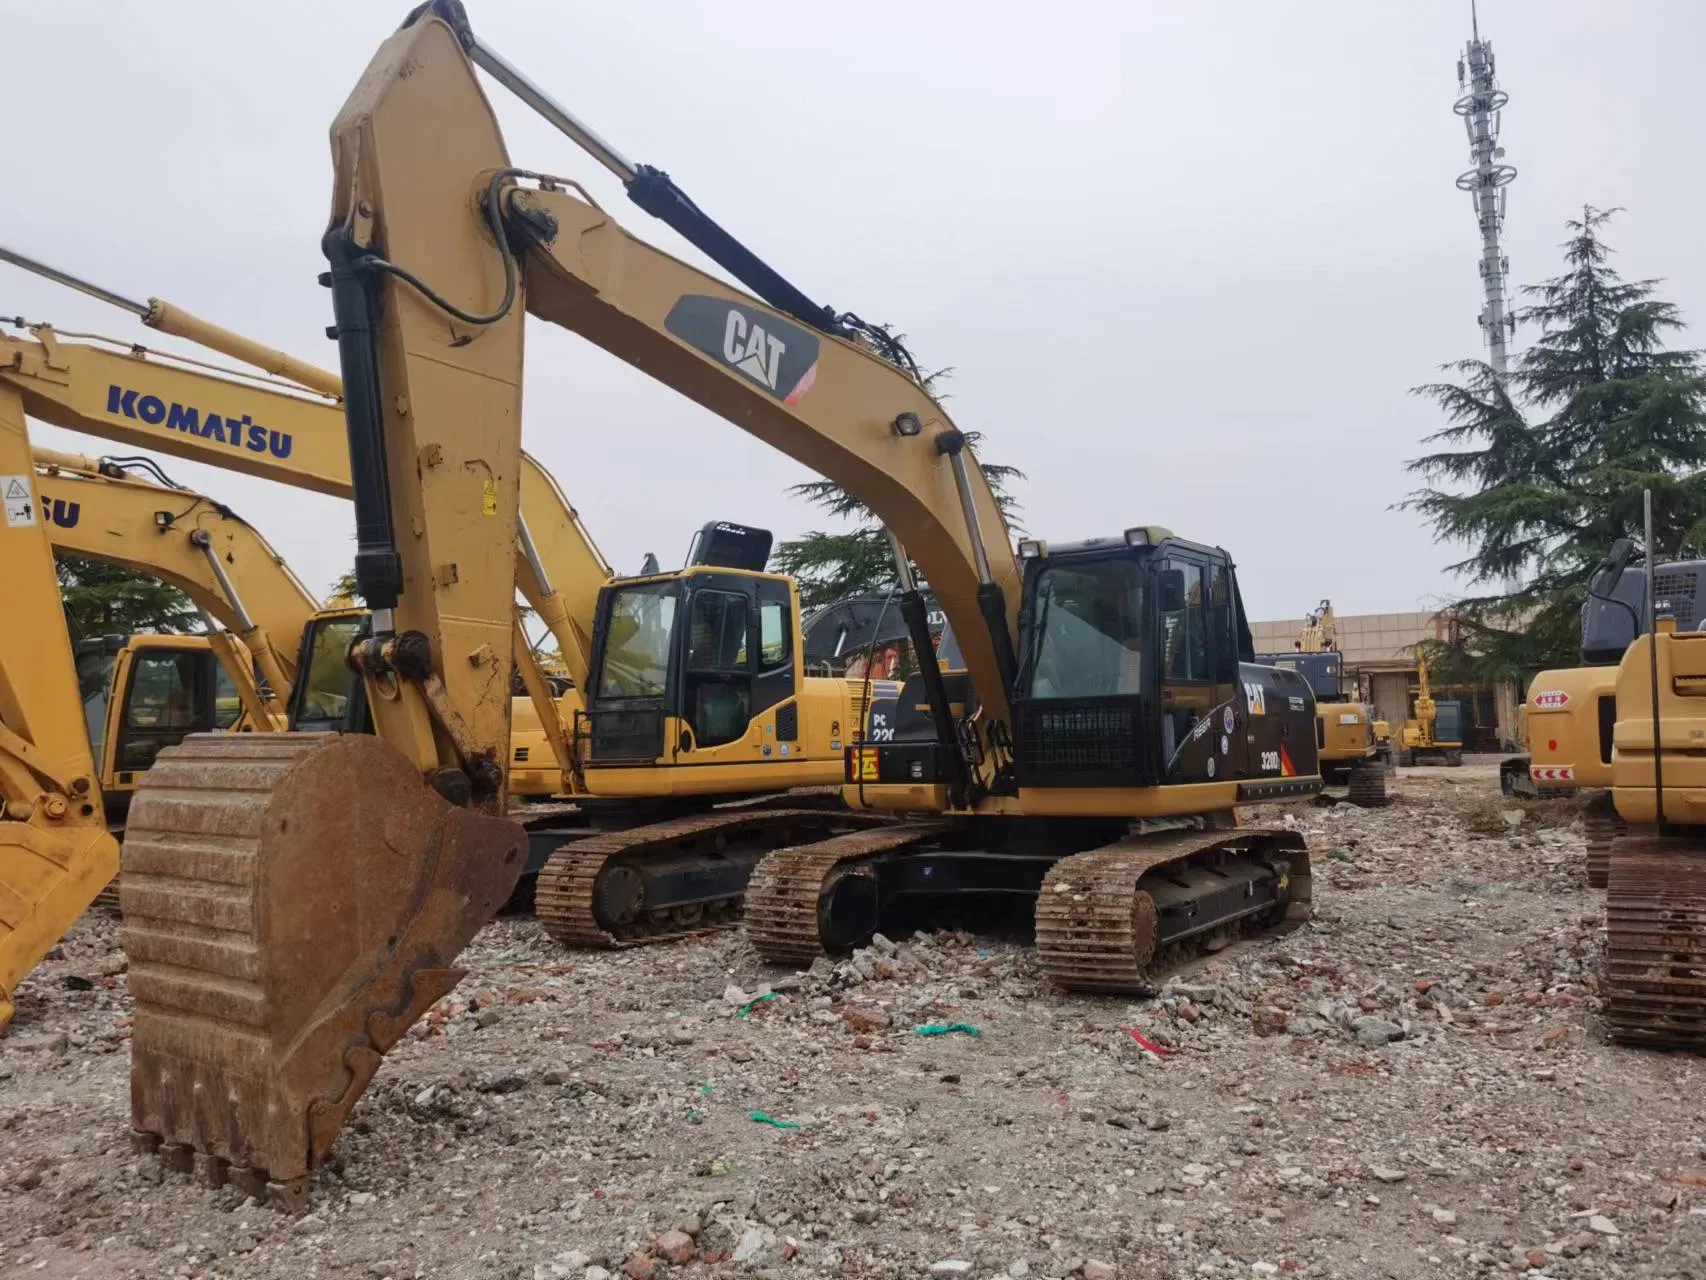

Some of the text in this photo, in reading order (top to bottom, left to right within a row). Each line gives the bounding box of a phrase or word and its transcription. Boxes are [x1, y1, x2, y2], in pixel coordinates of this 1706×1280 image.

[723, 309, 786, 391] CAT
[106, 385, 293, 459] KOMATSU
[1244, 683, 1266, 716] CAT
[873, 714, 886, 727] PC
[1261, 751, 1279, 770] 320D
